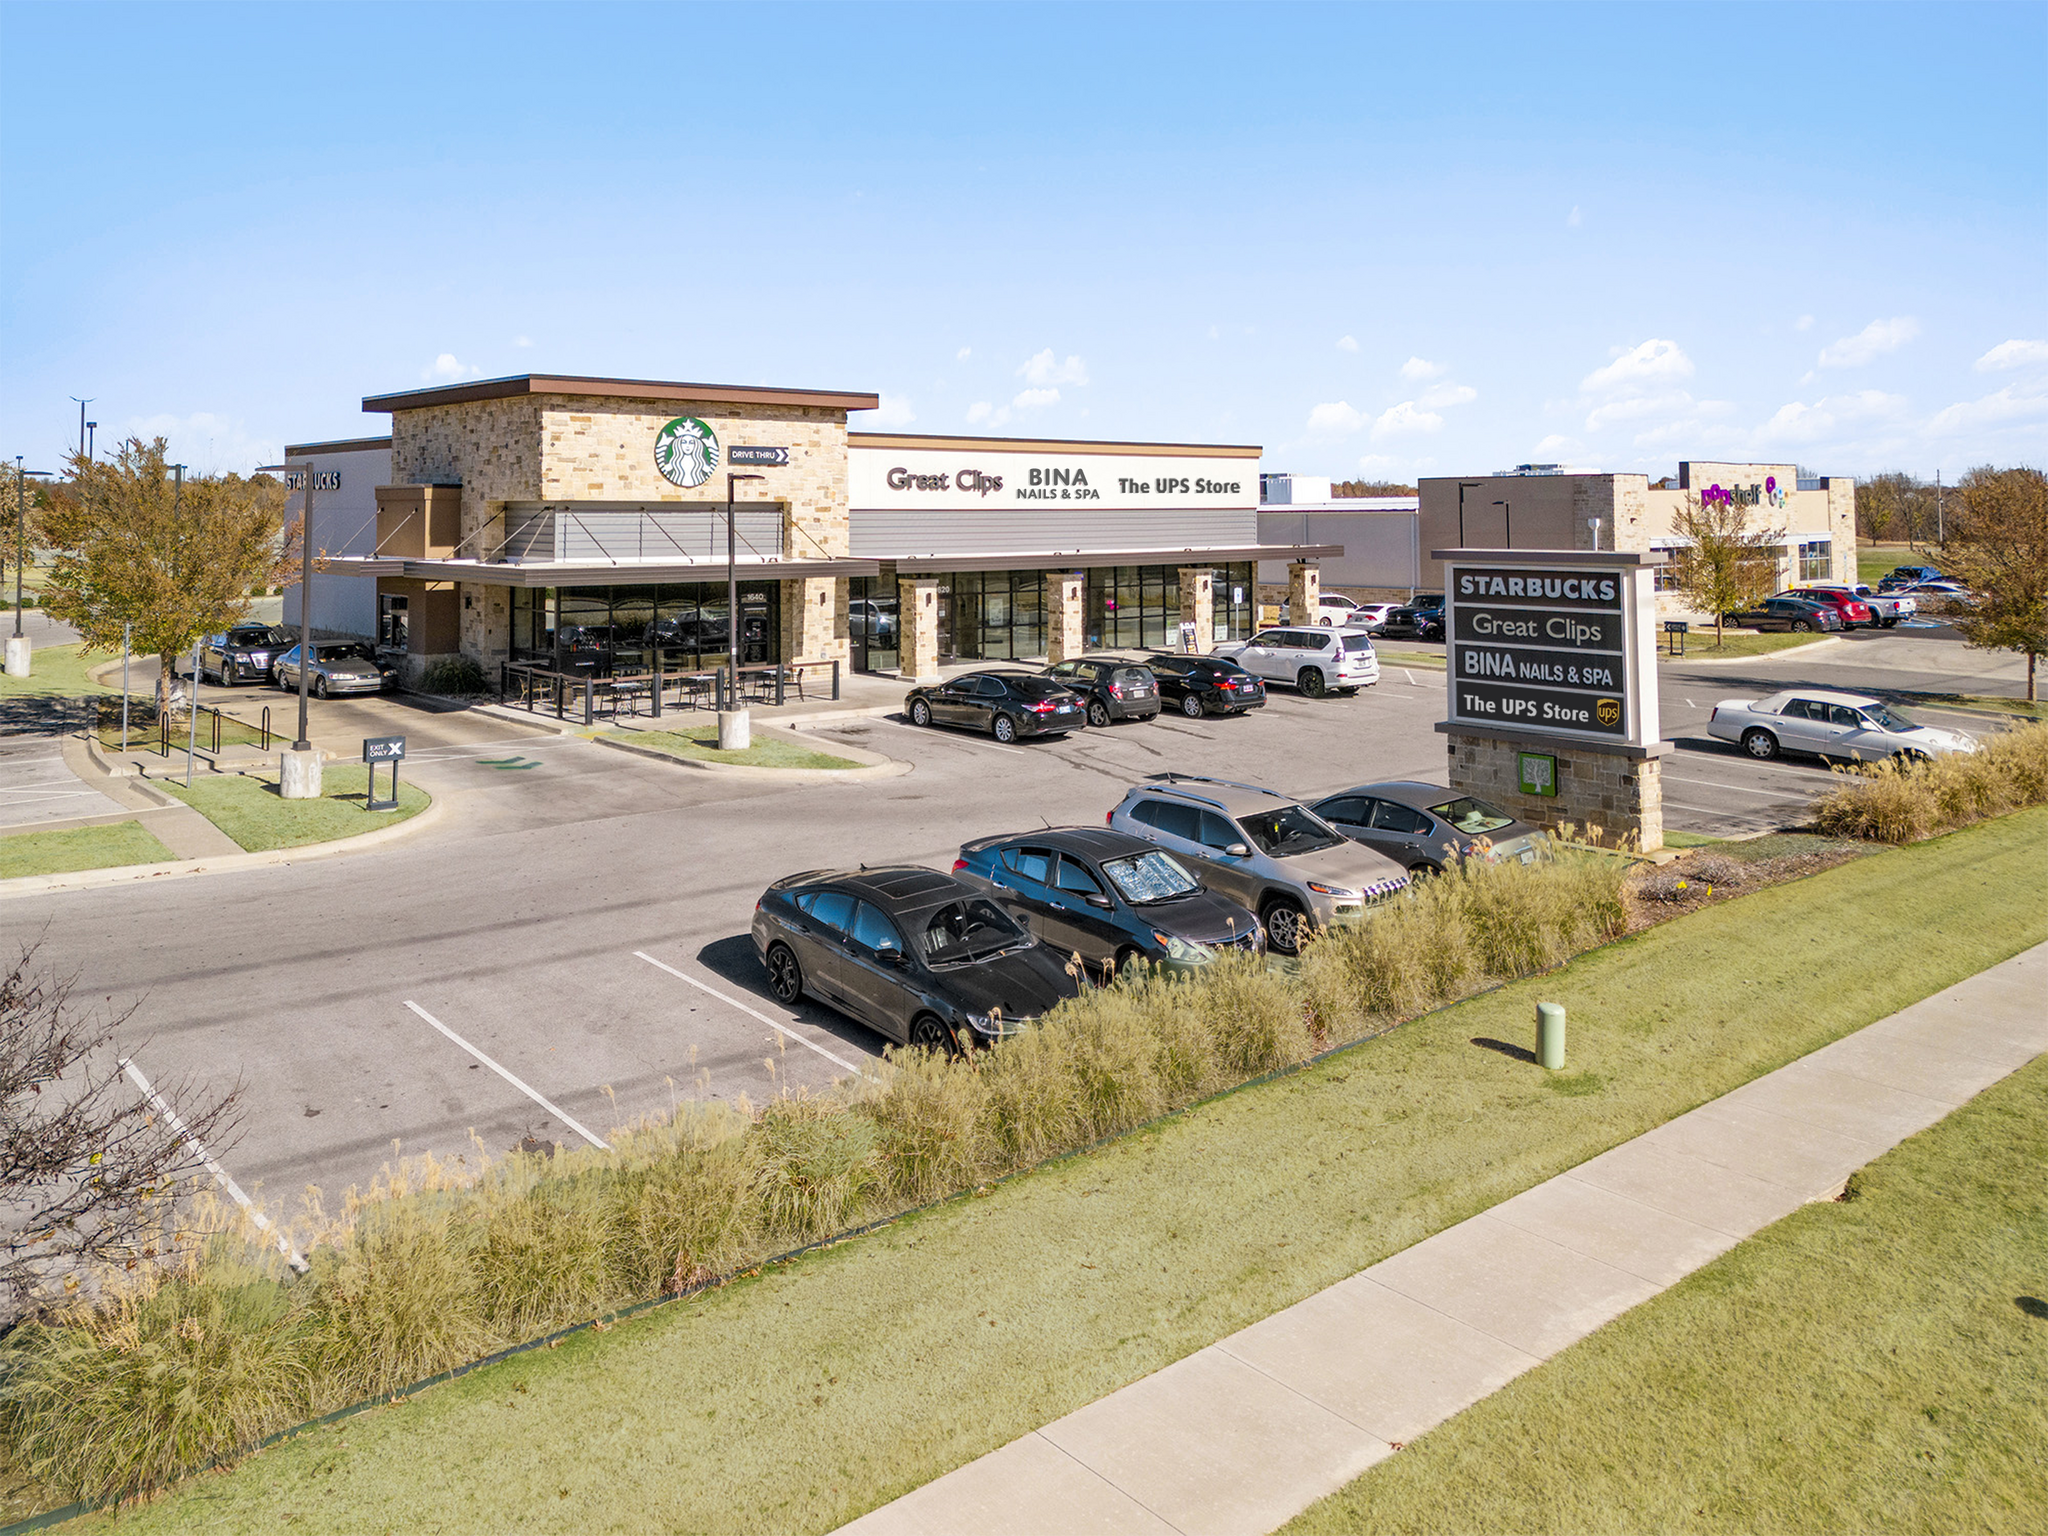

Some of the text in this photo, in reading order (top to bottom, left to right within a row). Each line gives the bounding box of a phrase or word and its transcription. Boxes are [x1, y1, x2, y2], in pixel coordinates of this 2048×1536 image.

[732, 450, 775, 460] DRIVE THRU
[286, 472, 341, 490] STARUCKS
[887, 467, 1004, 498] Great Clips
[1029, 468, 1088, 486] BINA
[1118, 478, 1241, 494] The UPS Store
[1016, 488, 1100, 500] NAILS & SPA
[1701, 484, 1761, 509] popshelf
[747, 593, 764, 601] 1640
[1460, 575, 1616, 601] STARBUCKS
[1472, 613, 1602, 646] Great Clips
[1464, 651, 1613, 687] BINA NAILS & SPA
[1463, 694, 1590, 723] The UPS Store
